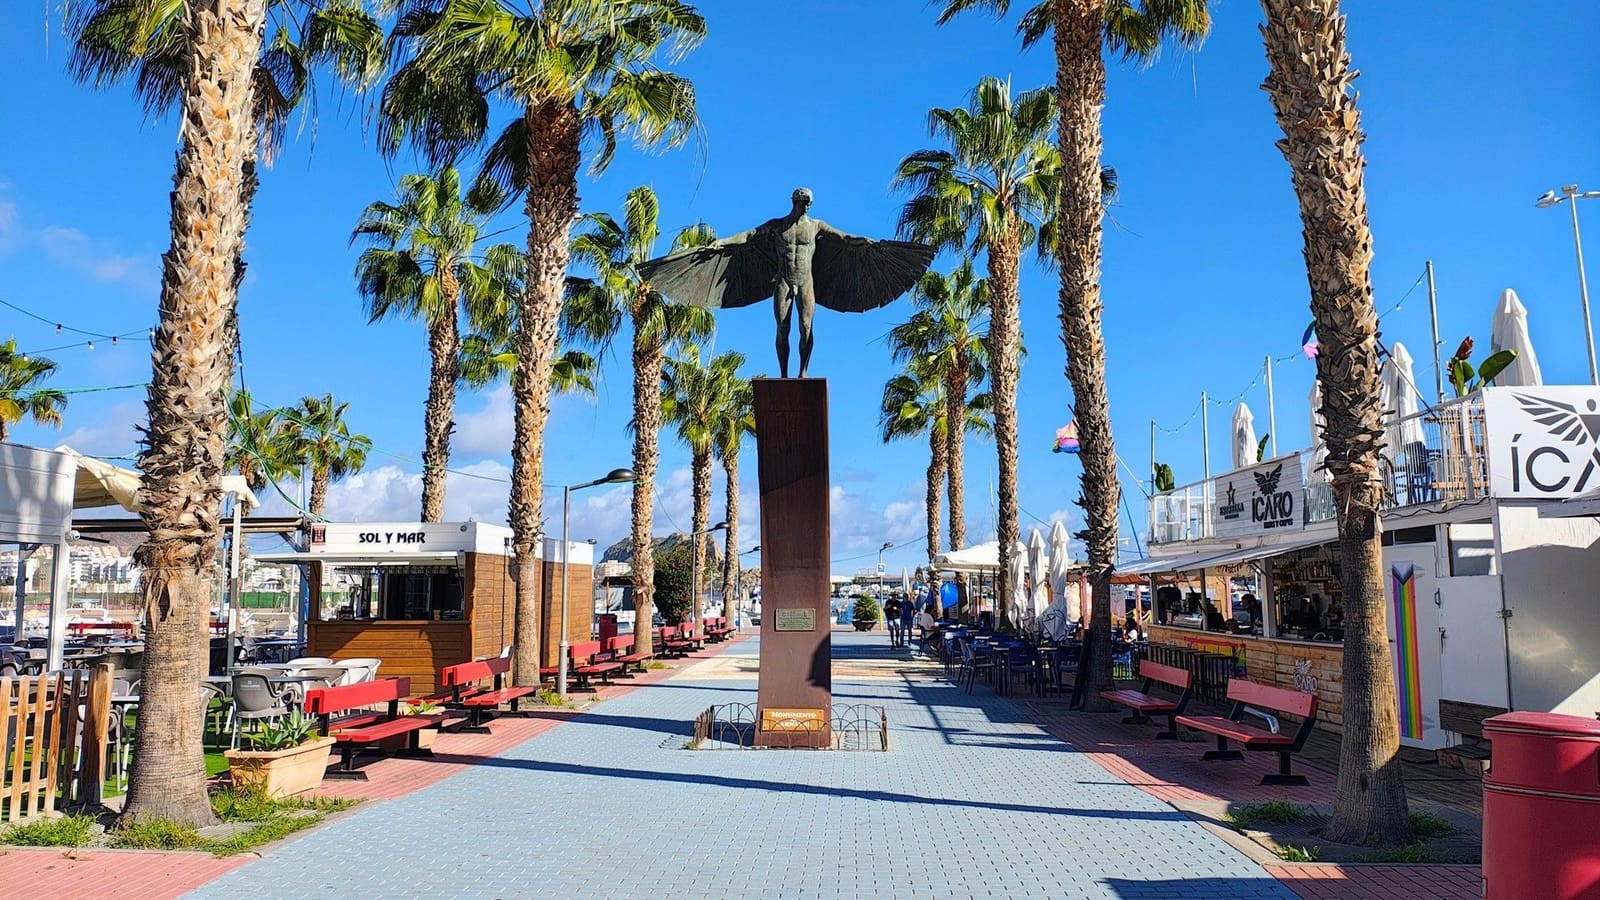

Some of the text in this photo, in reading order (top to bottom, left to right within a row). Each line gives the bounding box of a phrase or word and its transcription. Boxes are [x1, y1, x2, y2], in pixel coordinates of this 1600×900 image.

[1251, 491, 1293, 522] ÍCARO
[359, 532, 425, 544] SOL Y MAR
